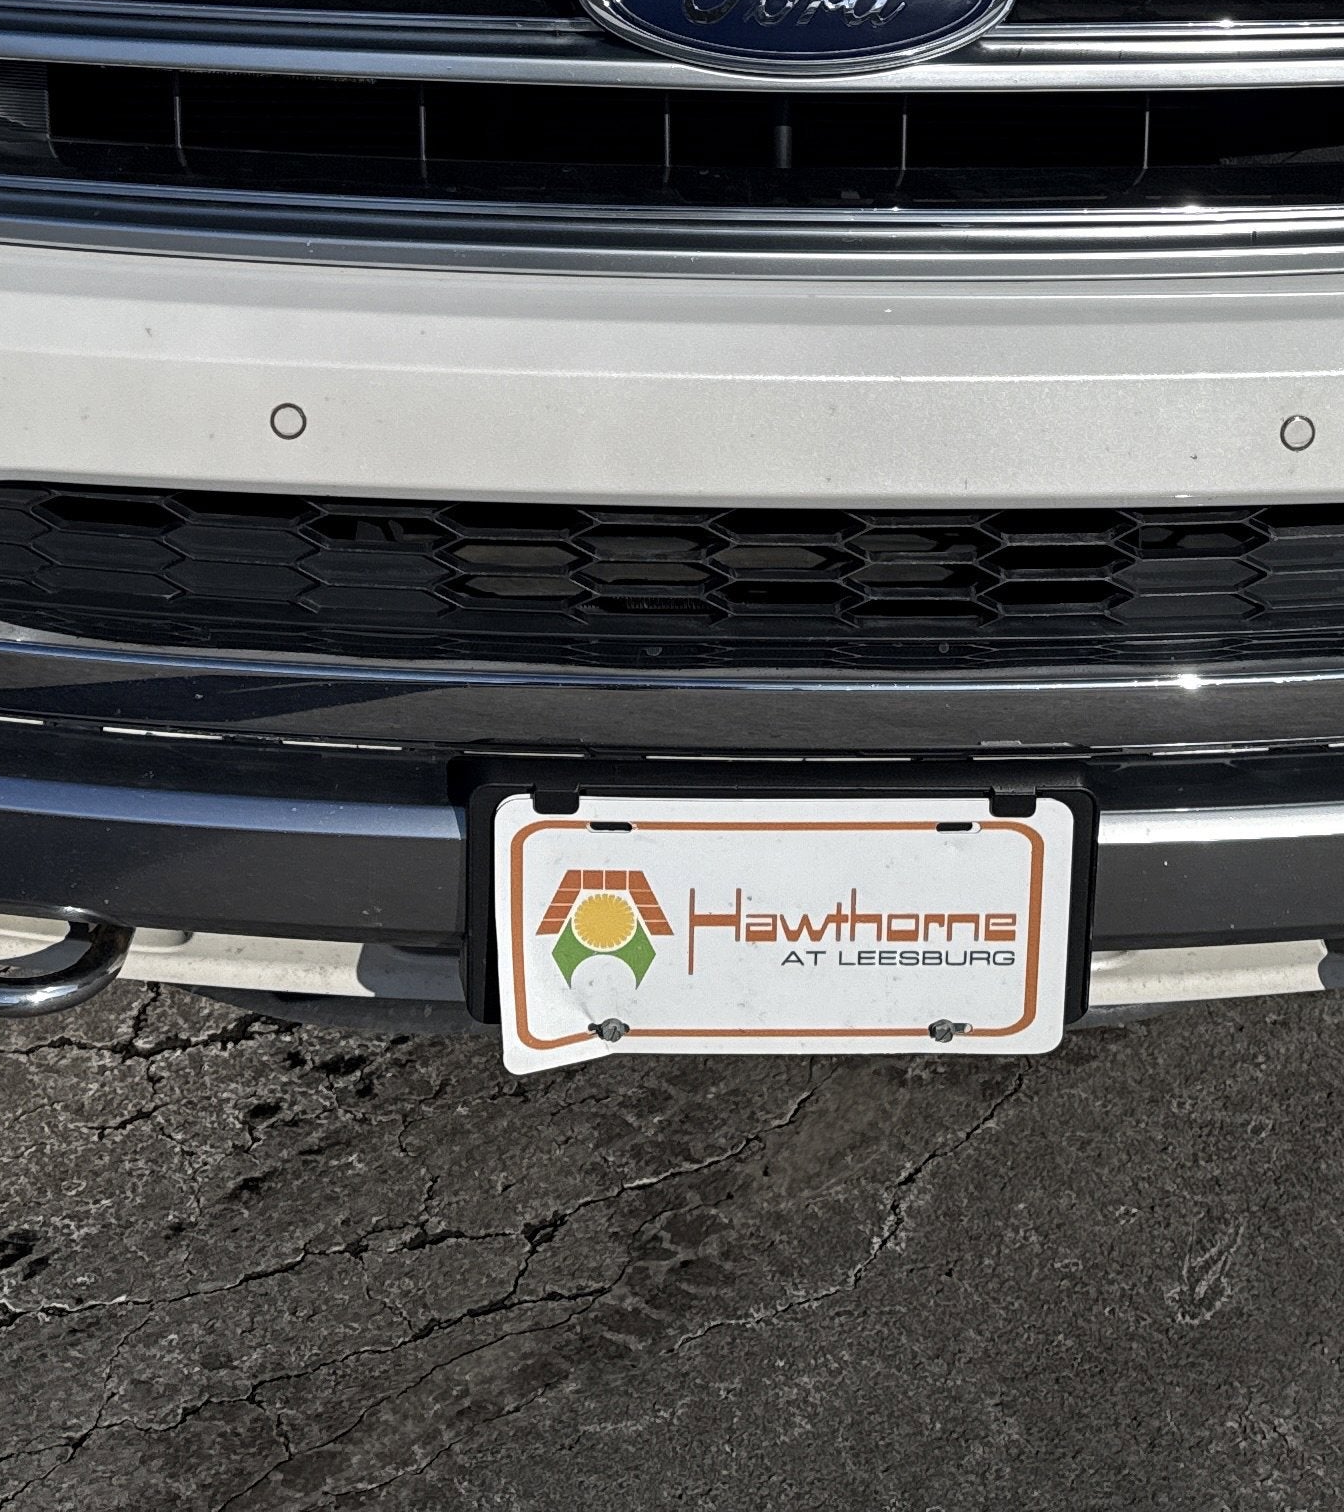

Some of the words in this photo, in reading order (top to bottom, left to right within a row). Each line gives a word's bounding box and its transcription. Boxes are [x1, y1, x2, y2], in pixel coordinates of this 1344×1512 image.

[687, 888, 1017, 975] Hawthorne
[780, 951, 827, 967] AT
[839, 951, 1016, 967] LEESBURG
